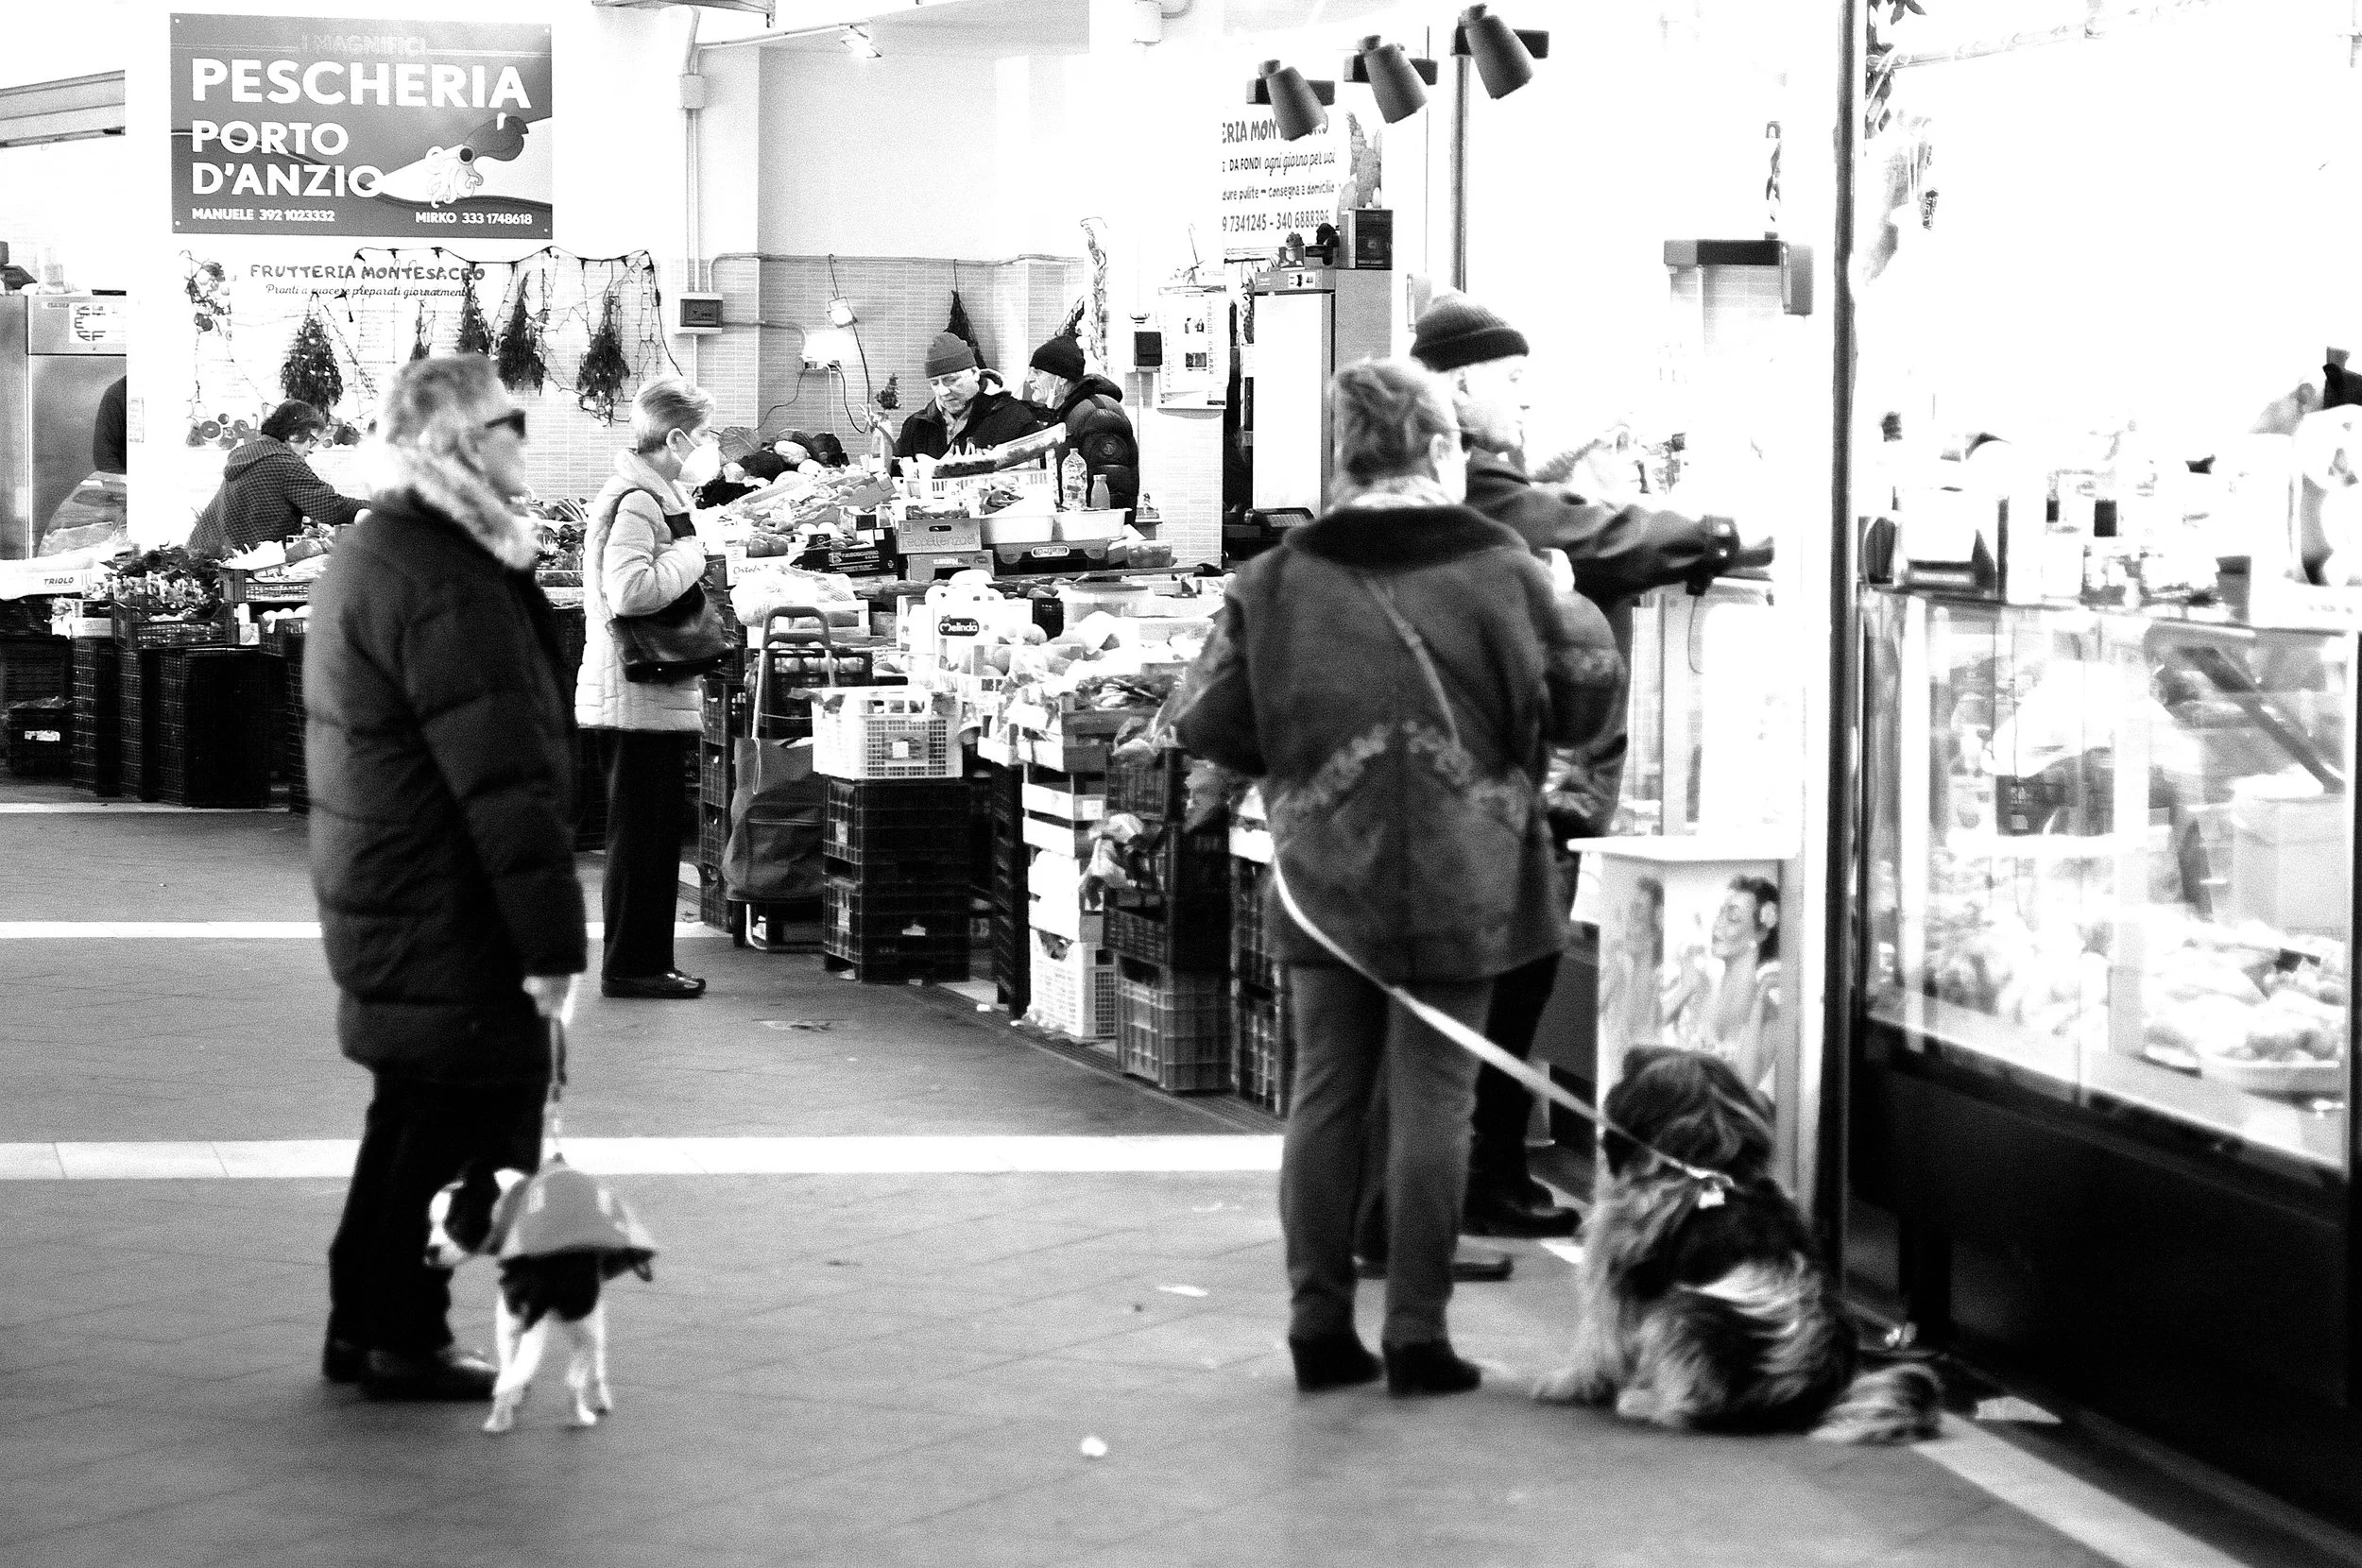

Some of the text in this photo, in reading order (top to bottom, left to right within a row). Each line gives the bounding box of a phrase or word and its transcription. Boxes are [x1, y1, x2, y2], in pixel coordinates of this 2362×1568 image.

[314, 34, 426, 56] MAGNIFICI
[192, 58, 532, 109] PESCHERIA
[192, 120, 349, 156] PORTO
[1230, 159, 1240, 171] DA
[1241, 157, 1261, 171] FONDI
[192, 162, 385, 198] D'ANZIO
[1269, 186, 1300, 199] consegna
[192, 208, 335, 223] MANUELE 392 1023332
[415, 212, 533, 226] MIRKO 333 1748618
[1230, 213, 1267, 232] 7341245
[1276, 211, 1292, 230] 340
[250, 264, 486, 281] FRUTTERIA MONTESACRO
[265, 283, 300, 296] Pronti
[351, 285, 401, 299] preparati
[403, 286, 470, 299] giornalment
[43, 576, 75, 586] TRIOLO
[938, 621, 979, 632] Melinda
